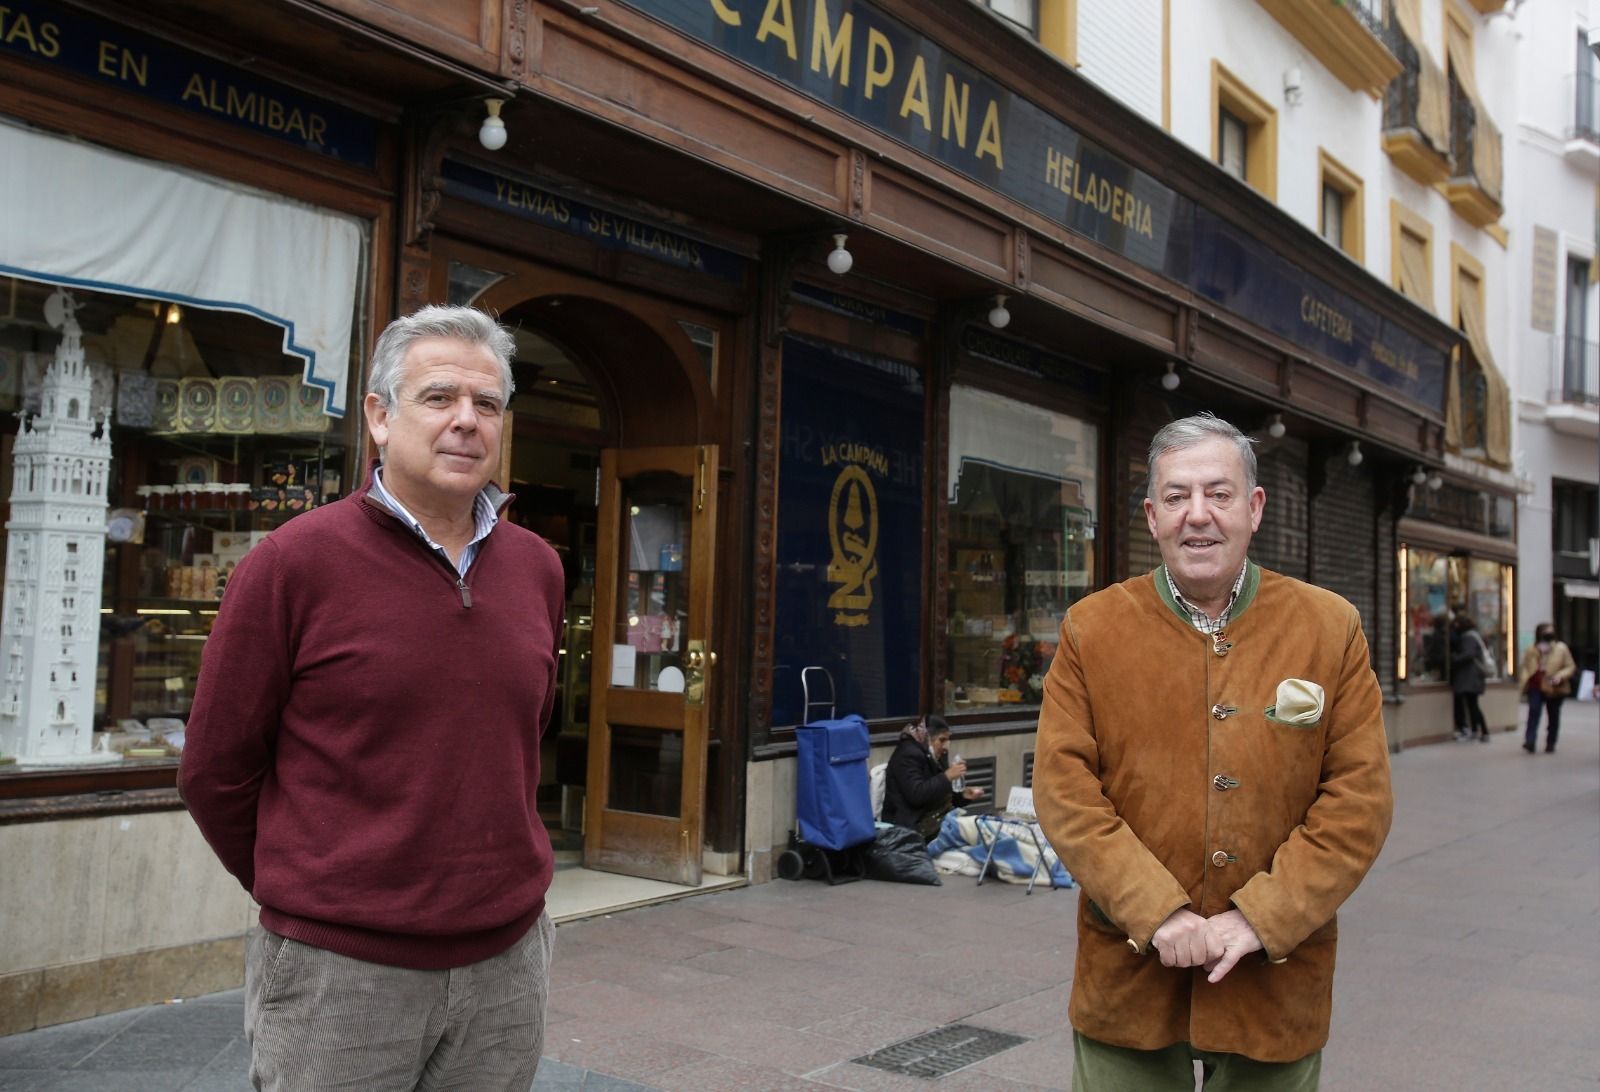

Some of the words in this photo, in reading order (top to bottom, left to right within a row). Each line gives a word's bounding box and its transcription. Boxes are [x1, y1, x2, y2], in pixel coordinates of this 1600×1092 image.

[98, 40, 148, 87] EN
[182, 73, 327, 145] ALMIBAR
[495, 178, 570, 223] YEMAS
[588, 210, 702, 266] SEVILLANAS
[1045, 146, 1153, 240] HELADERIA
[821, 444, 838, 466] LA
[838, 442, 889, 477] CAMPANA
